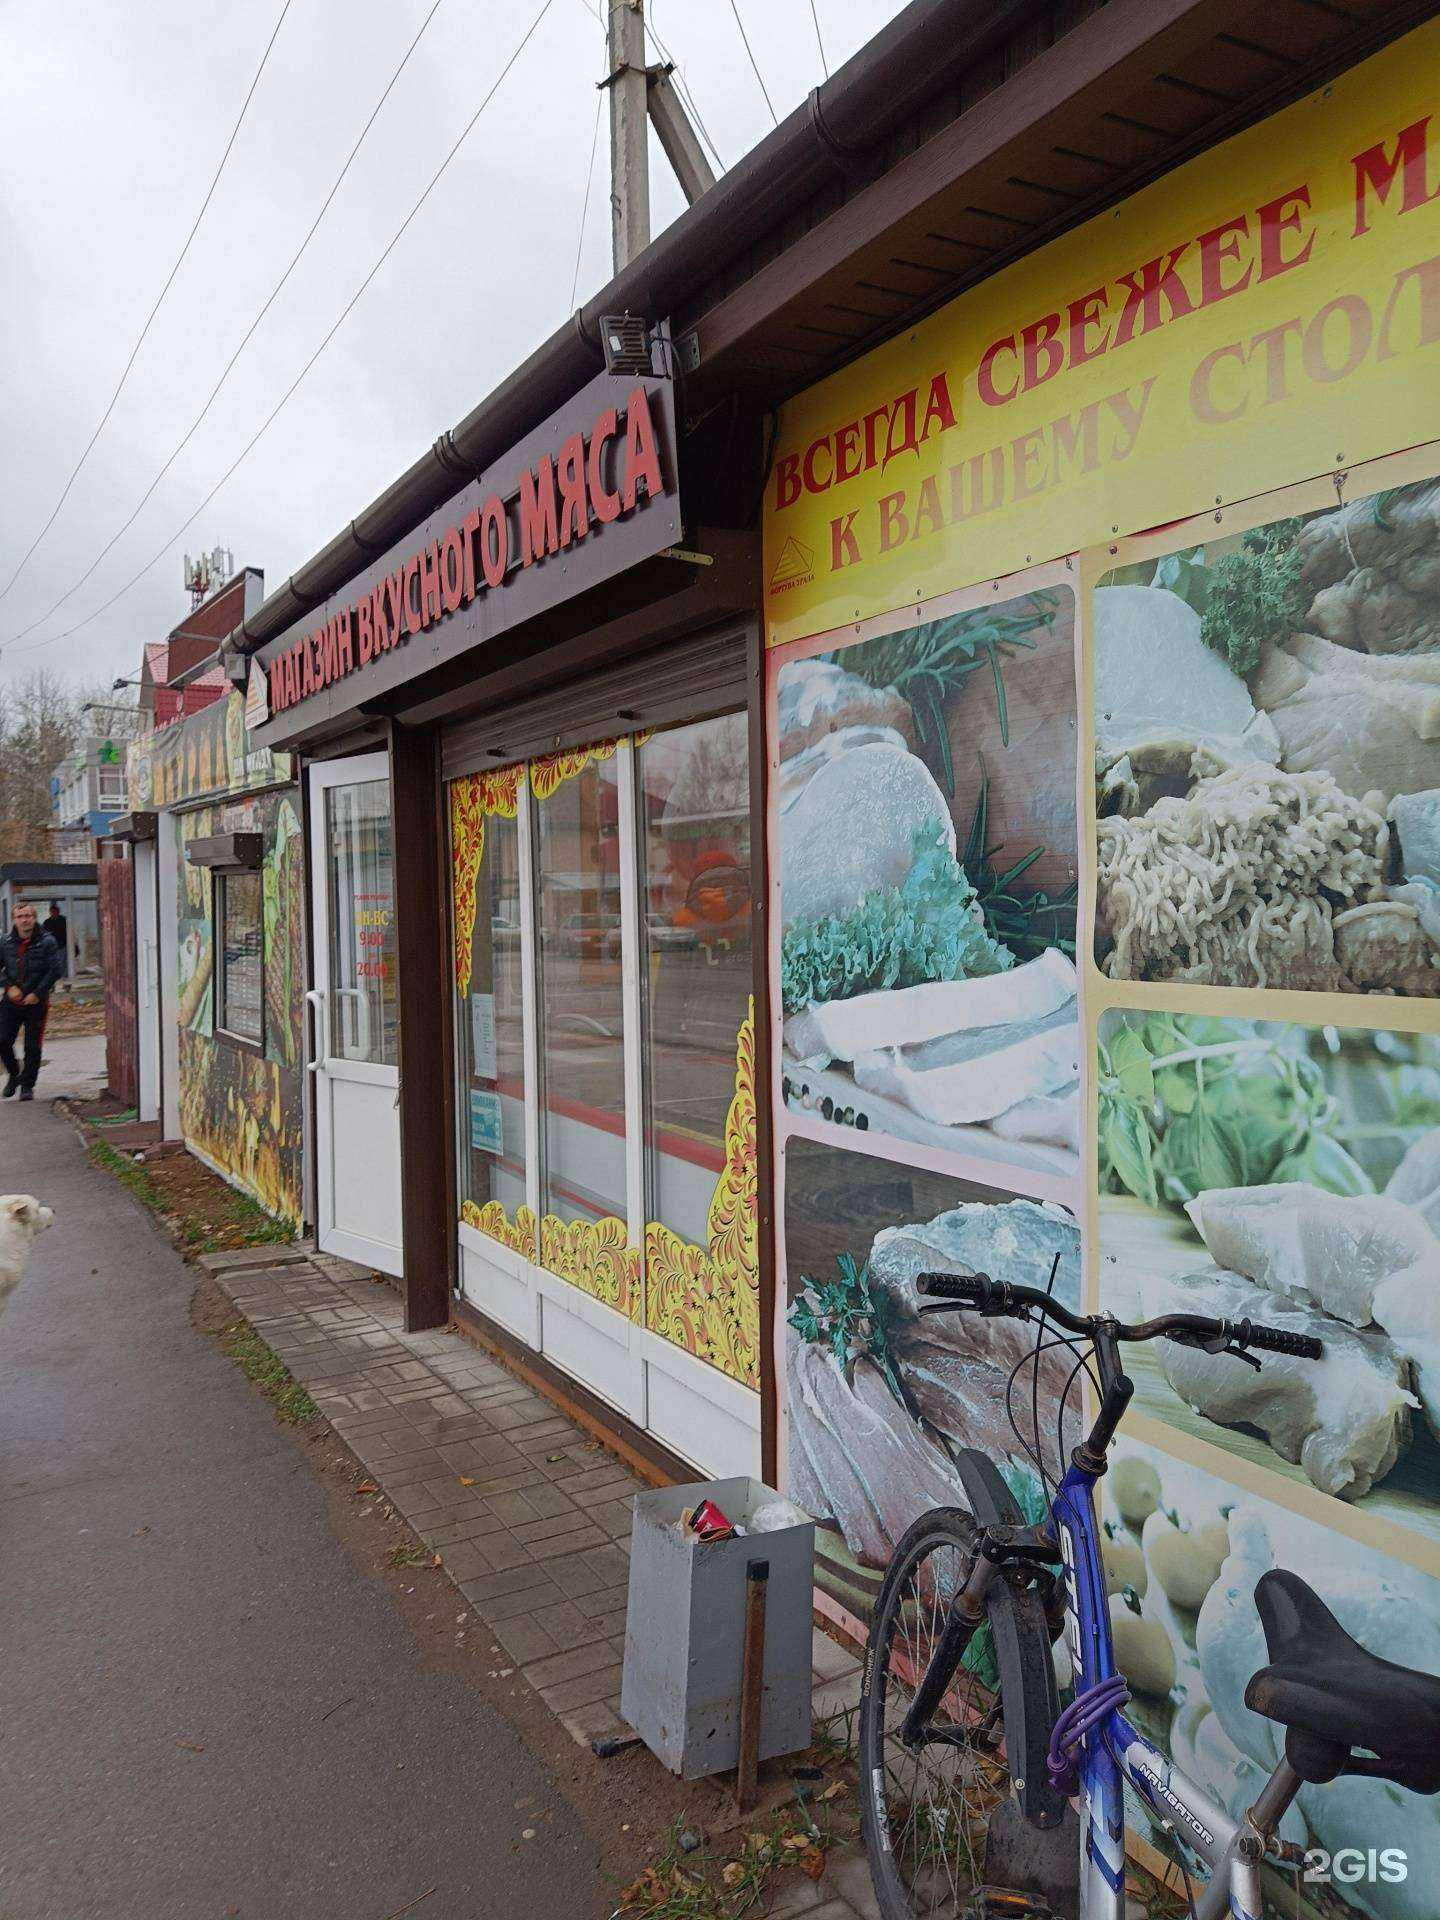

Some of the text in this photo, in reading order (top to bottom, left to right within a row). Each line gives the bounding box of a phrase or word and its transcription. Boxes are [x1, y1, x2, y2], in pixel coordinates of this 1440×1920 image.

[774, 115, 1440, 511] ВСЕГДА СВЕЖЕЕ М
[270, 385, 664, 715] МАГАЗИН ВКУСНОГО МЯСА
[829, 508, 861, 572] К
[878, 376, 1158, 553] ВАШЕМУ
[1138, 1763, 1215, 1847] NAVIGATOR
